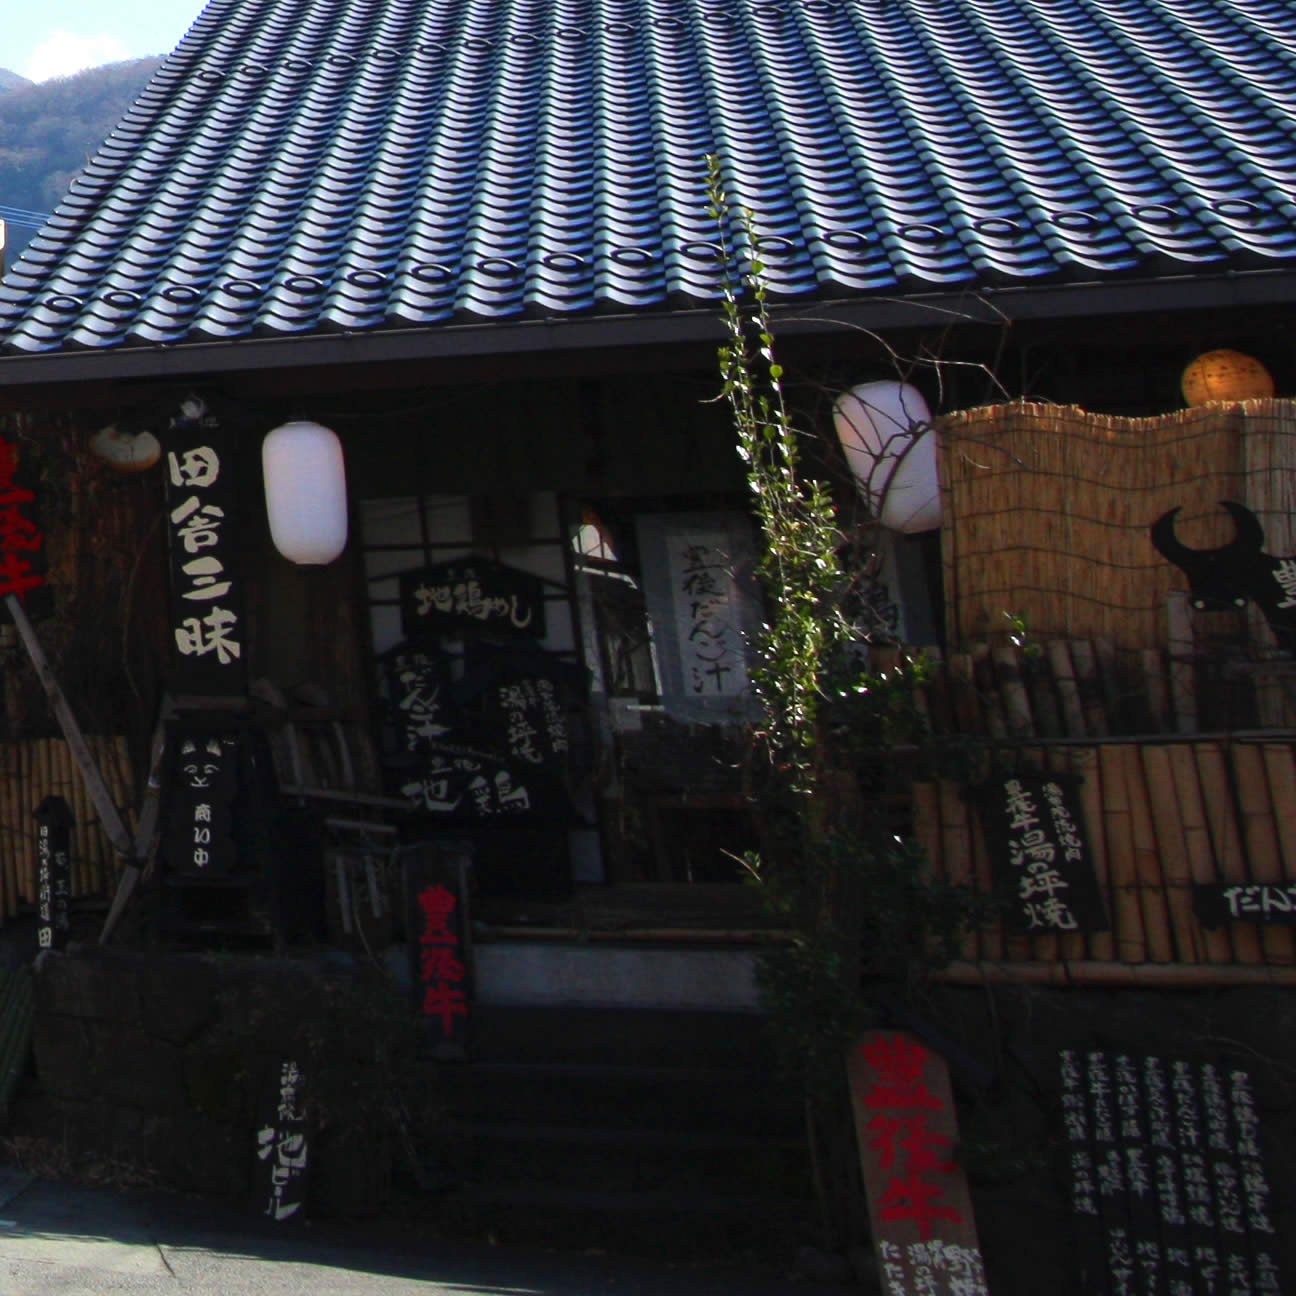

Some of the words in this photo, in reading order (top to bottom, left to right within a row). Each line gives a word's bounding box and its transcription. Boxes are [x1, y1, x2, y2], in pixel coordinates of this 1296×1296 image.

[167, 445, 241, 665] 田舎三昧
[414, 581, 533, 629] 地鶏めし
[193, 803, 211, 868] 商い中
[417, 883, 469, 1039] 豊後牛
[861, 1035, 964, 1241] 豊後牛
